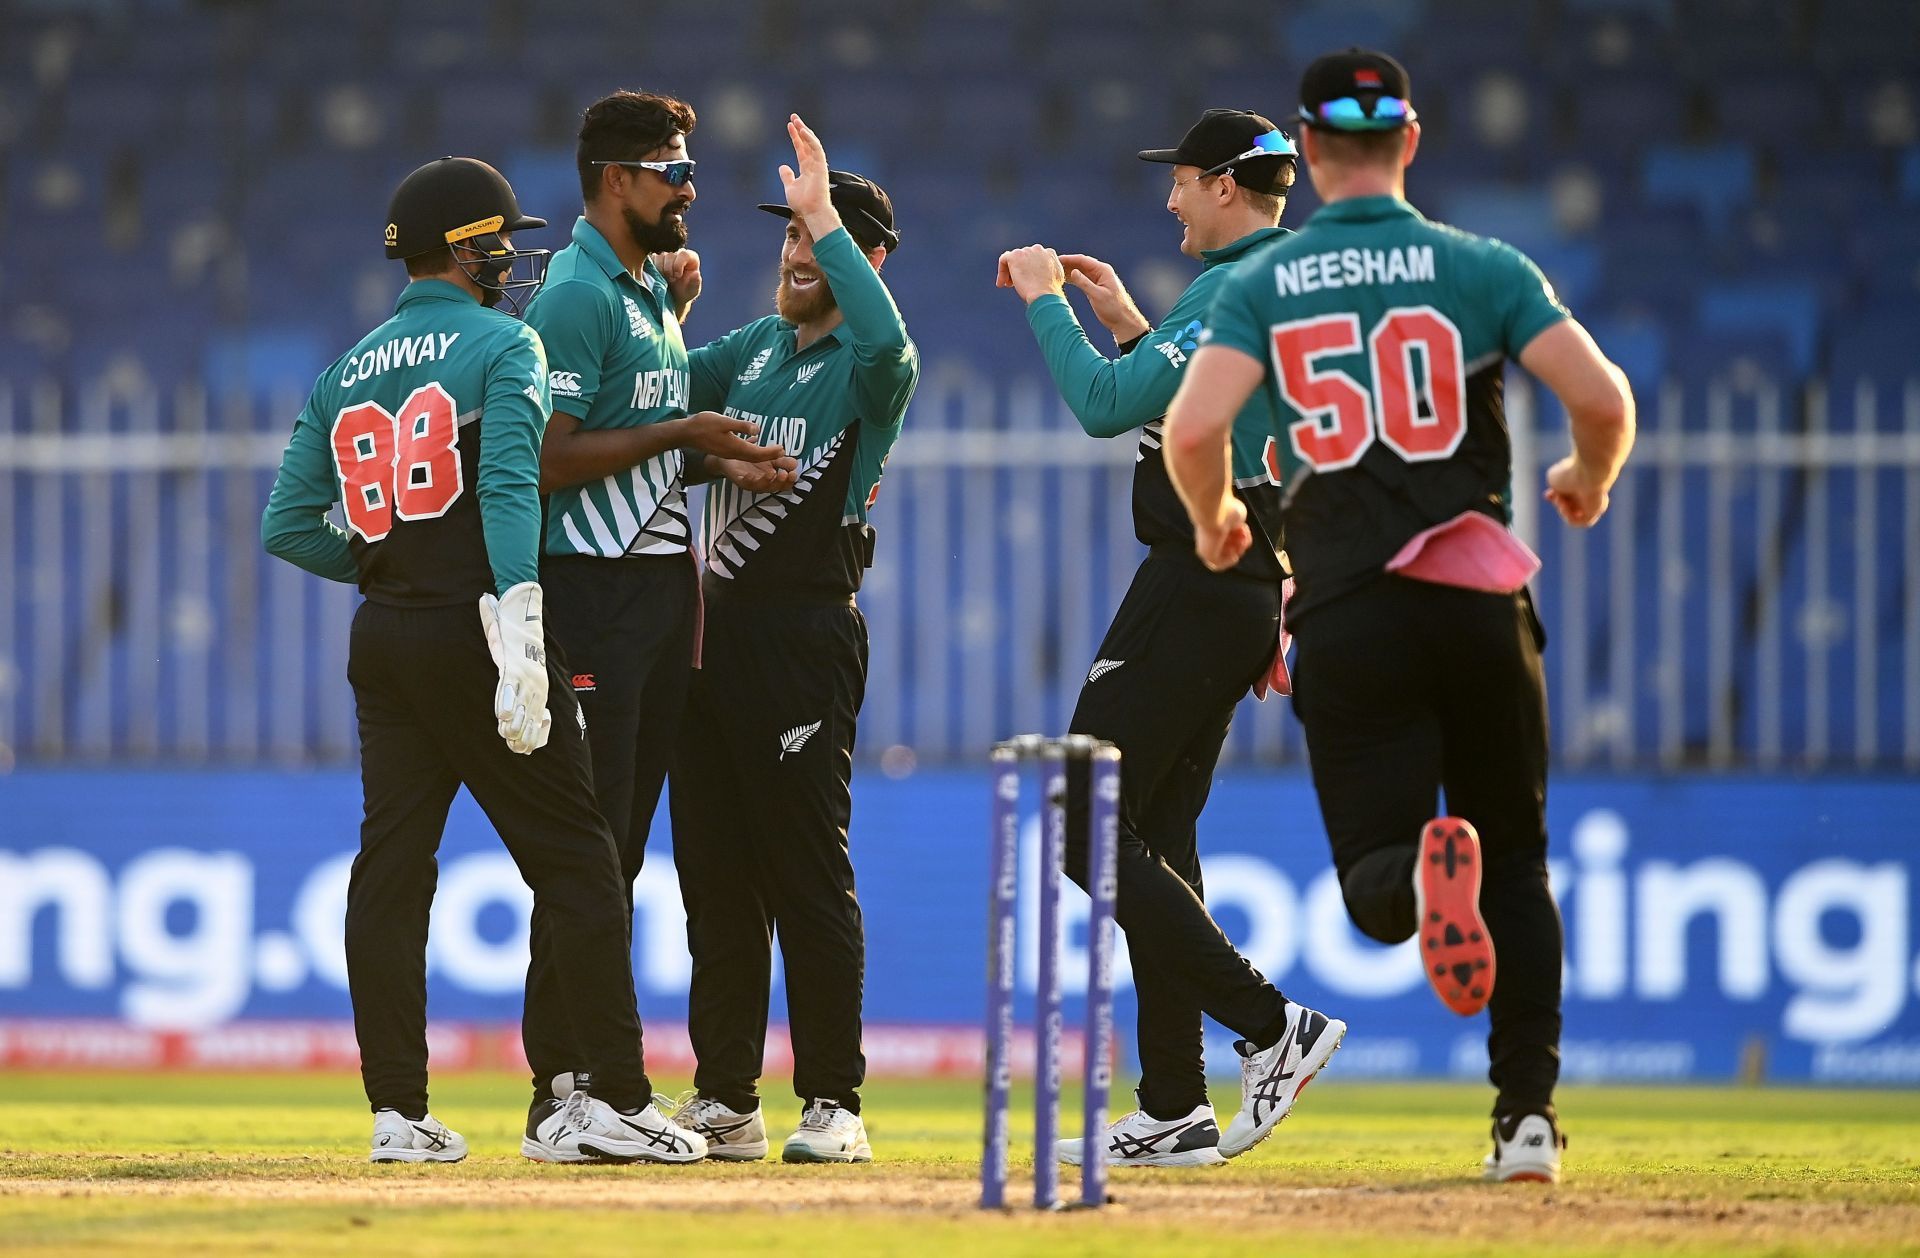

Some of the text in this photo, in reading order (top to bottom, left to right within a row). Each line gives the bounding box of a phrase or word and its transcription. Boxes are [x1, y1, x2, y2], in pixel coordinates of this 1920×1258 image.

[1225, 167, 1235, 176] 37
[465, 220, 495, 233] MASURI
[1273, 245, 1436, 298] NEESHAM
[340, 332, 460, 388] CONWAY
[1153, 341, 1187, 369] ANZ
[550, 389, 582, 398] anterbury
[630, 369, 664, 410] NEW
[1269, 305, 1468, 474] 50
[330, 381, 464, 544] 88
